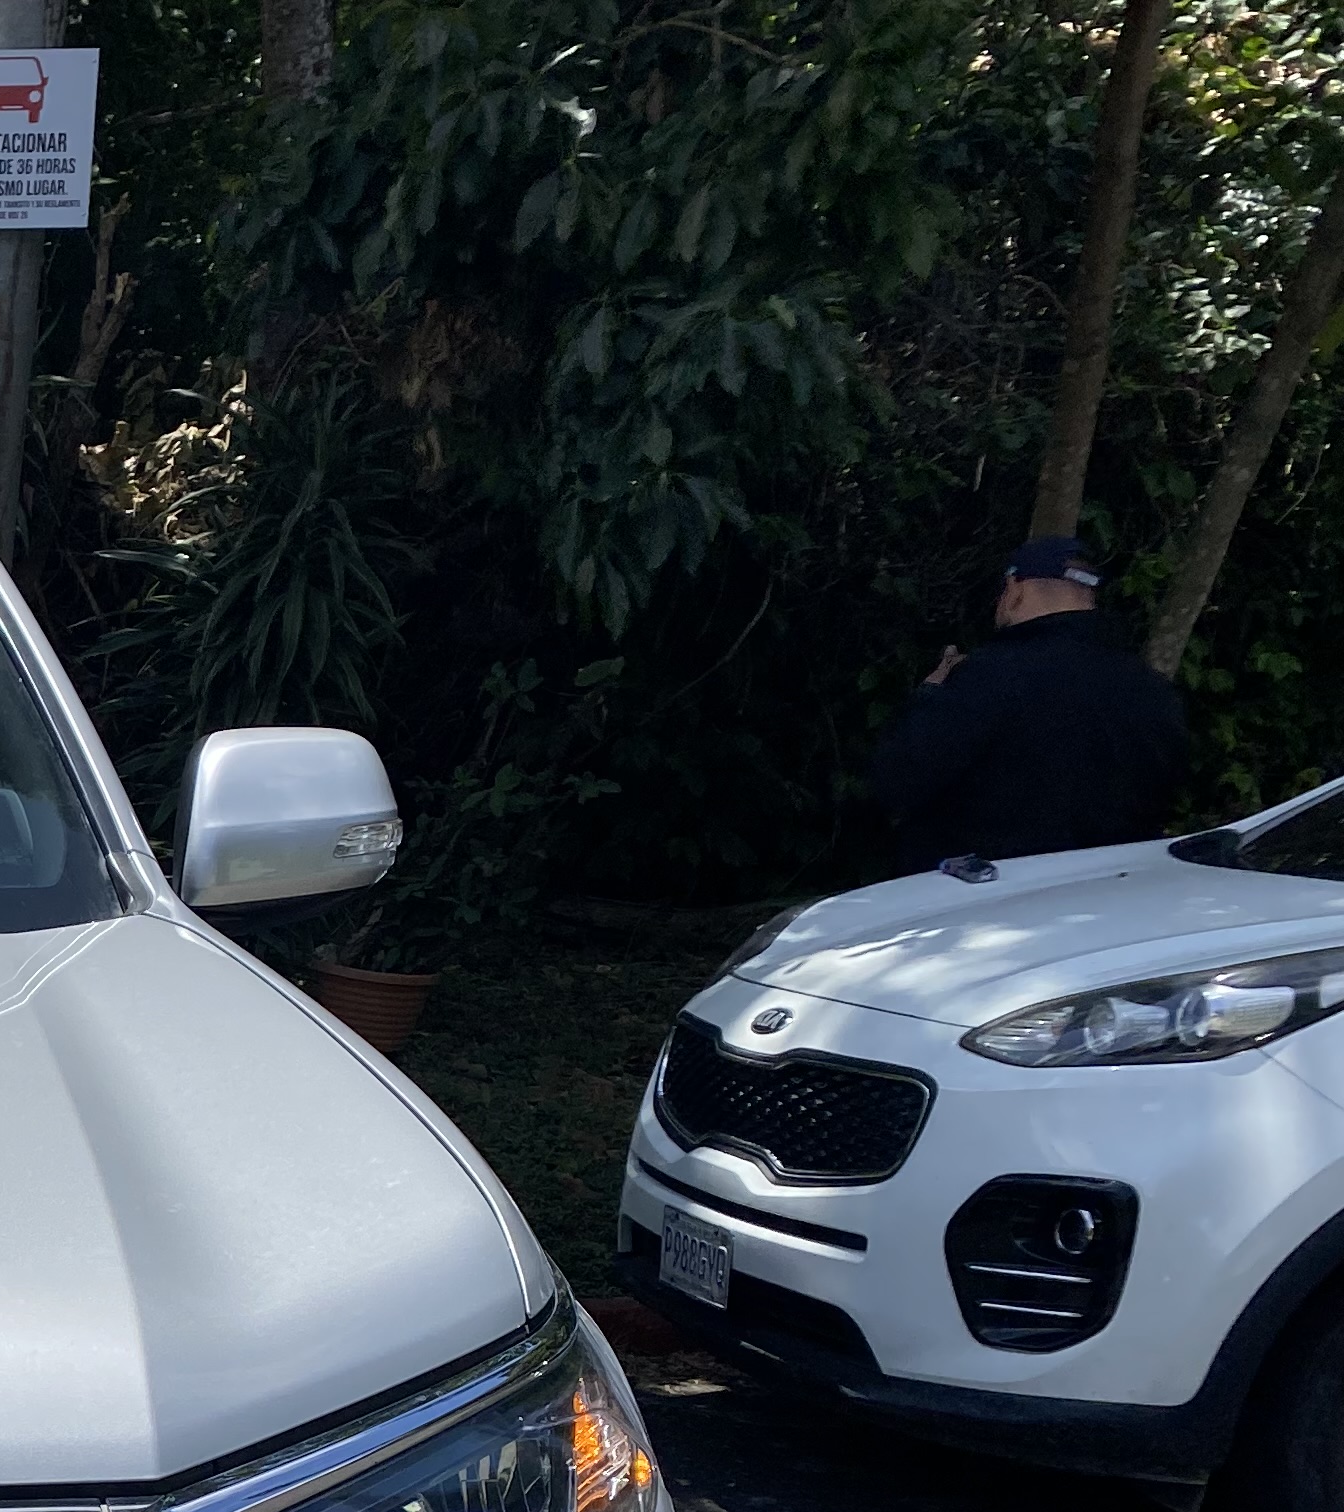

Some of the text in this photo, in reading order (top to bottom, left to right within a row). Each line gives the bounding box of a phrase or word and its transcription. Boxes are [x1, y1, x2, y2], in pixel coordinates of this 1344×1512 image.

[17, 159, 32, 175] 36
[35, 158, 76, 174] HORAS
[26, 179, 68, 196] LUGAR.
